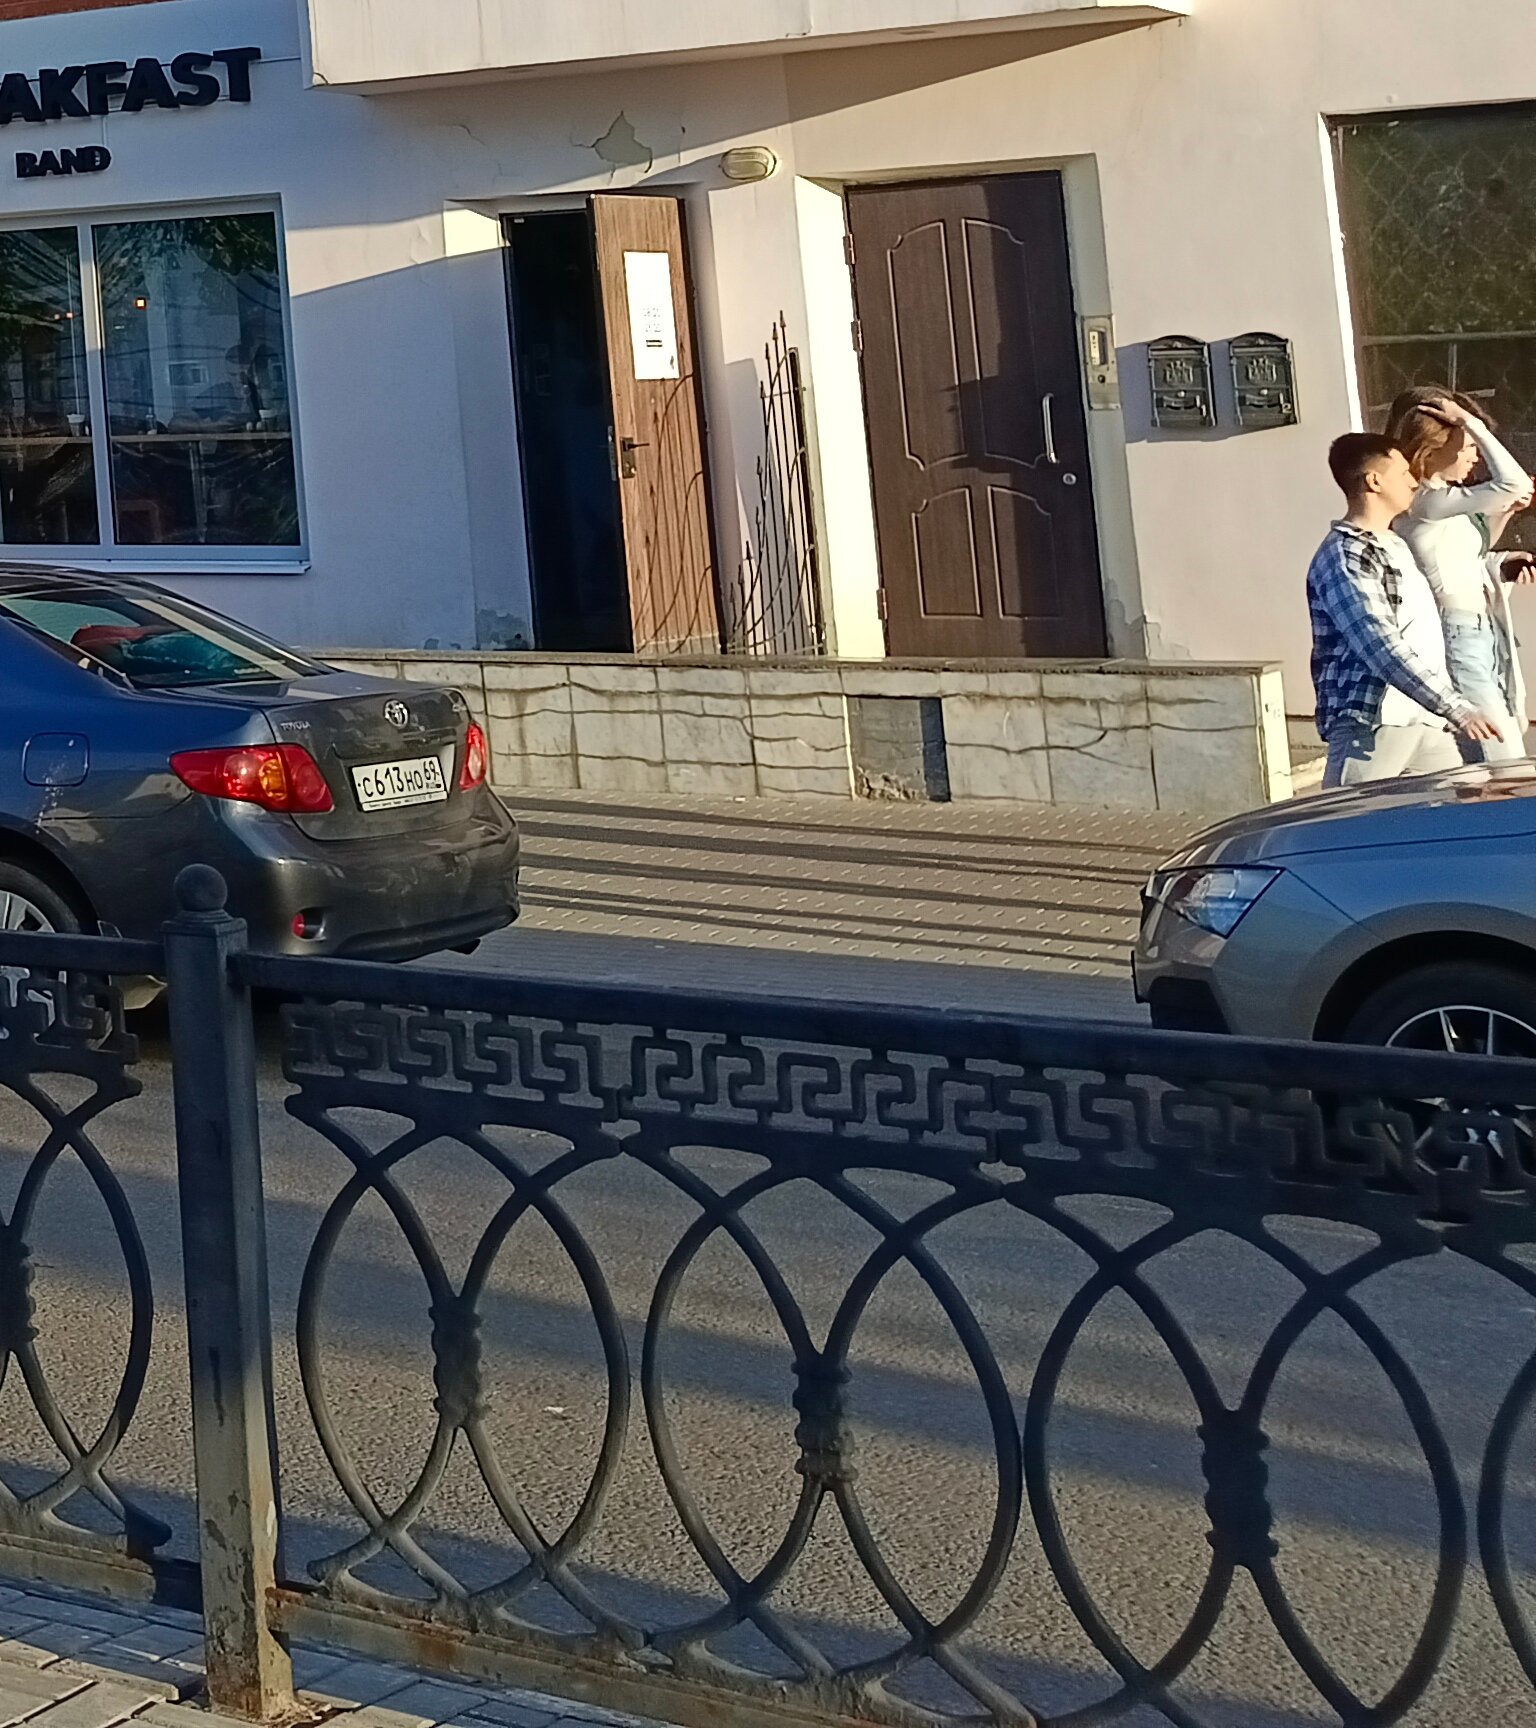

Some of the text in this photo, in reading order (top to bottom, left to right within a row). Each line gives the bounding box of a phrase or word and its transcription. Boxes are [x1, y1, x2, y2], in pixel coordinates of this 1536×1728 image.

[15, 145, 112, 179] BAND
[362, 759, 439, 798] С613НО 69
